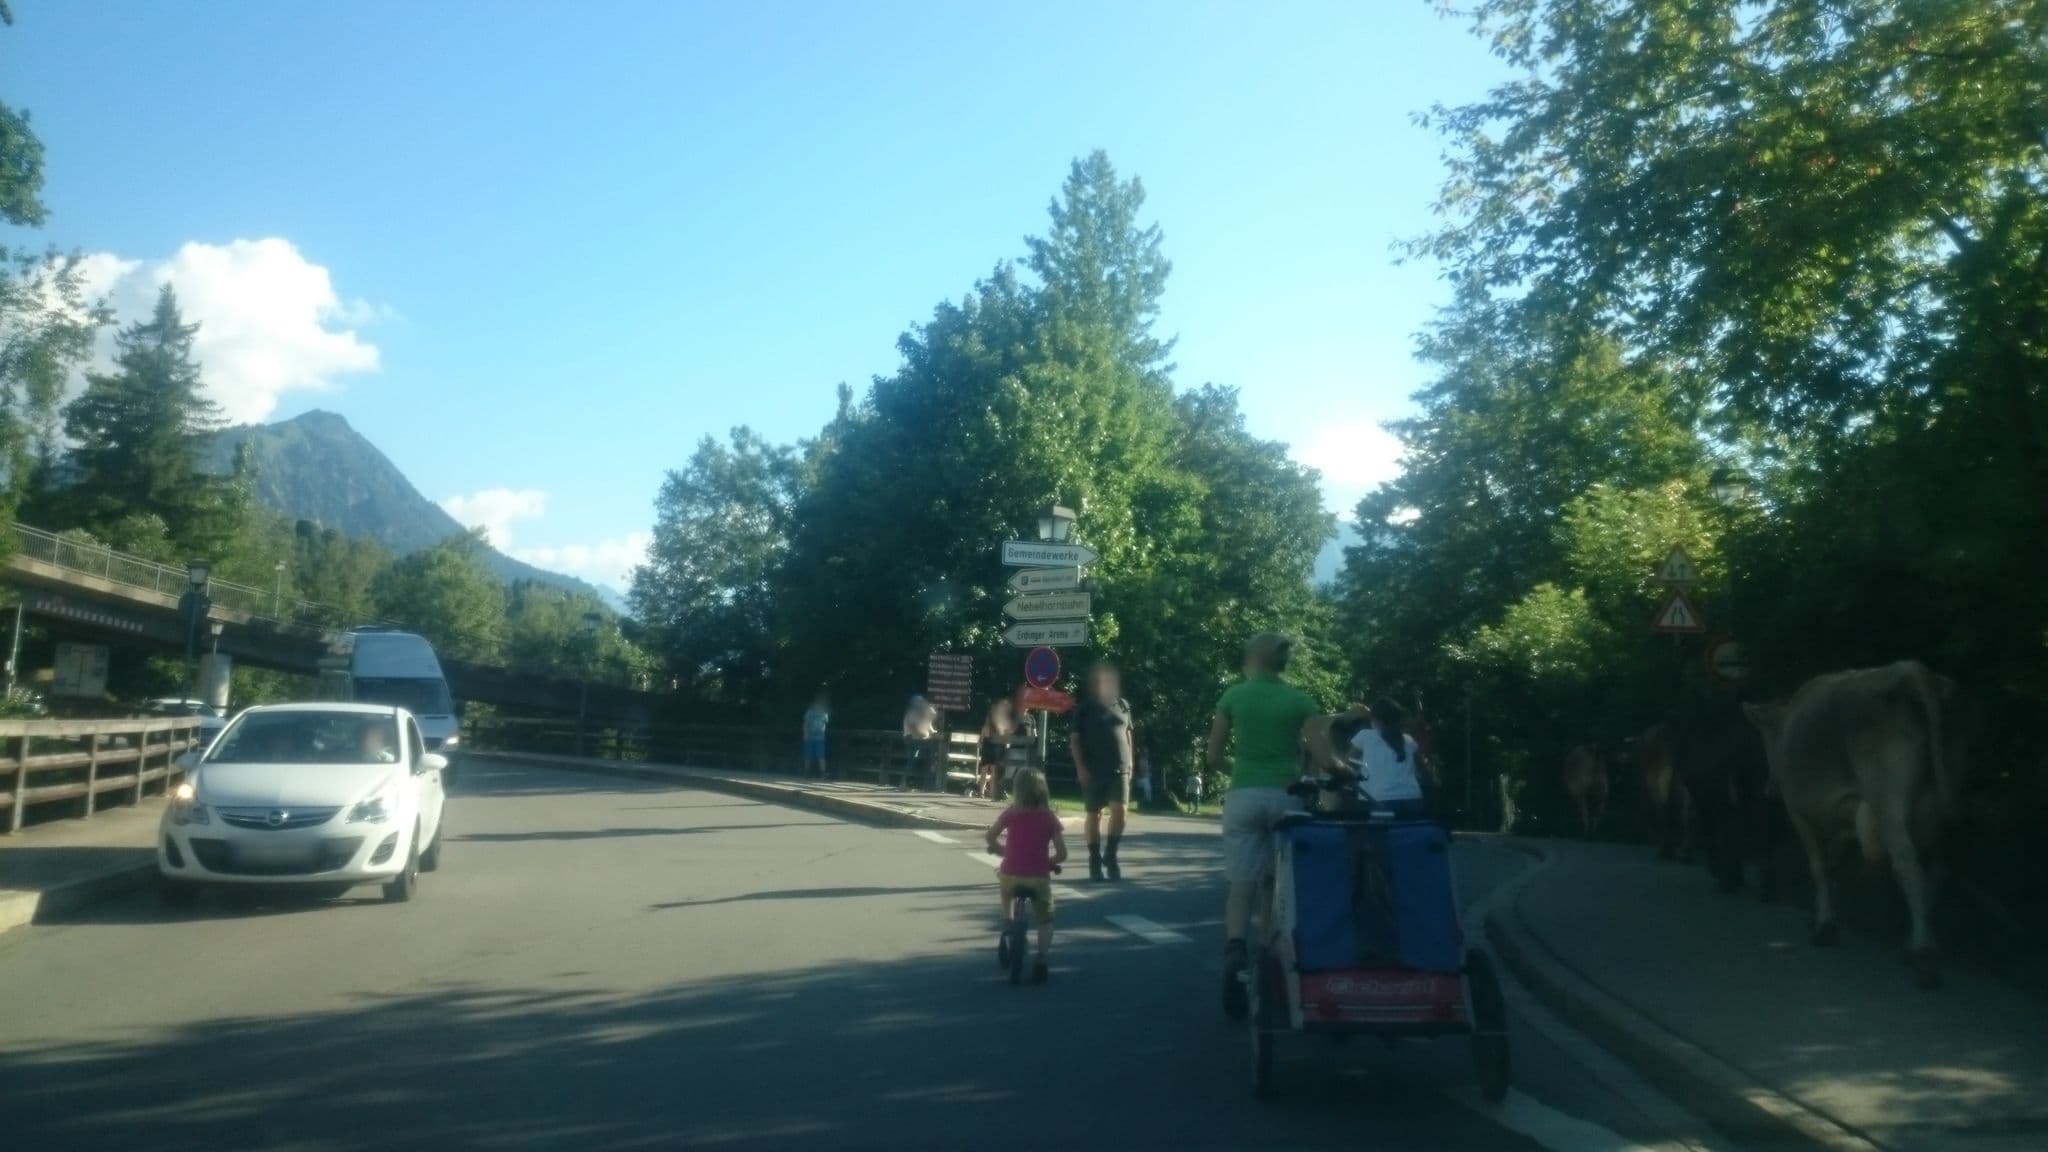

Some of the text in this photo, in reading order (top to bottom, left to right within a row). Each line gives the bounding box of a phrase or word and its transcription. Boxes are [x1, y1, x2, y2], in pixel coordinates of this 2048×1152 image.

[1008, 547, 1079, 561] Gemeindewerke
[1017, 598, 1084, 613] Nebelhornbahn
[1016, 630, 1045, 642] Erdinger
